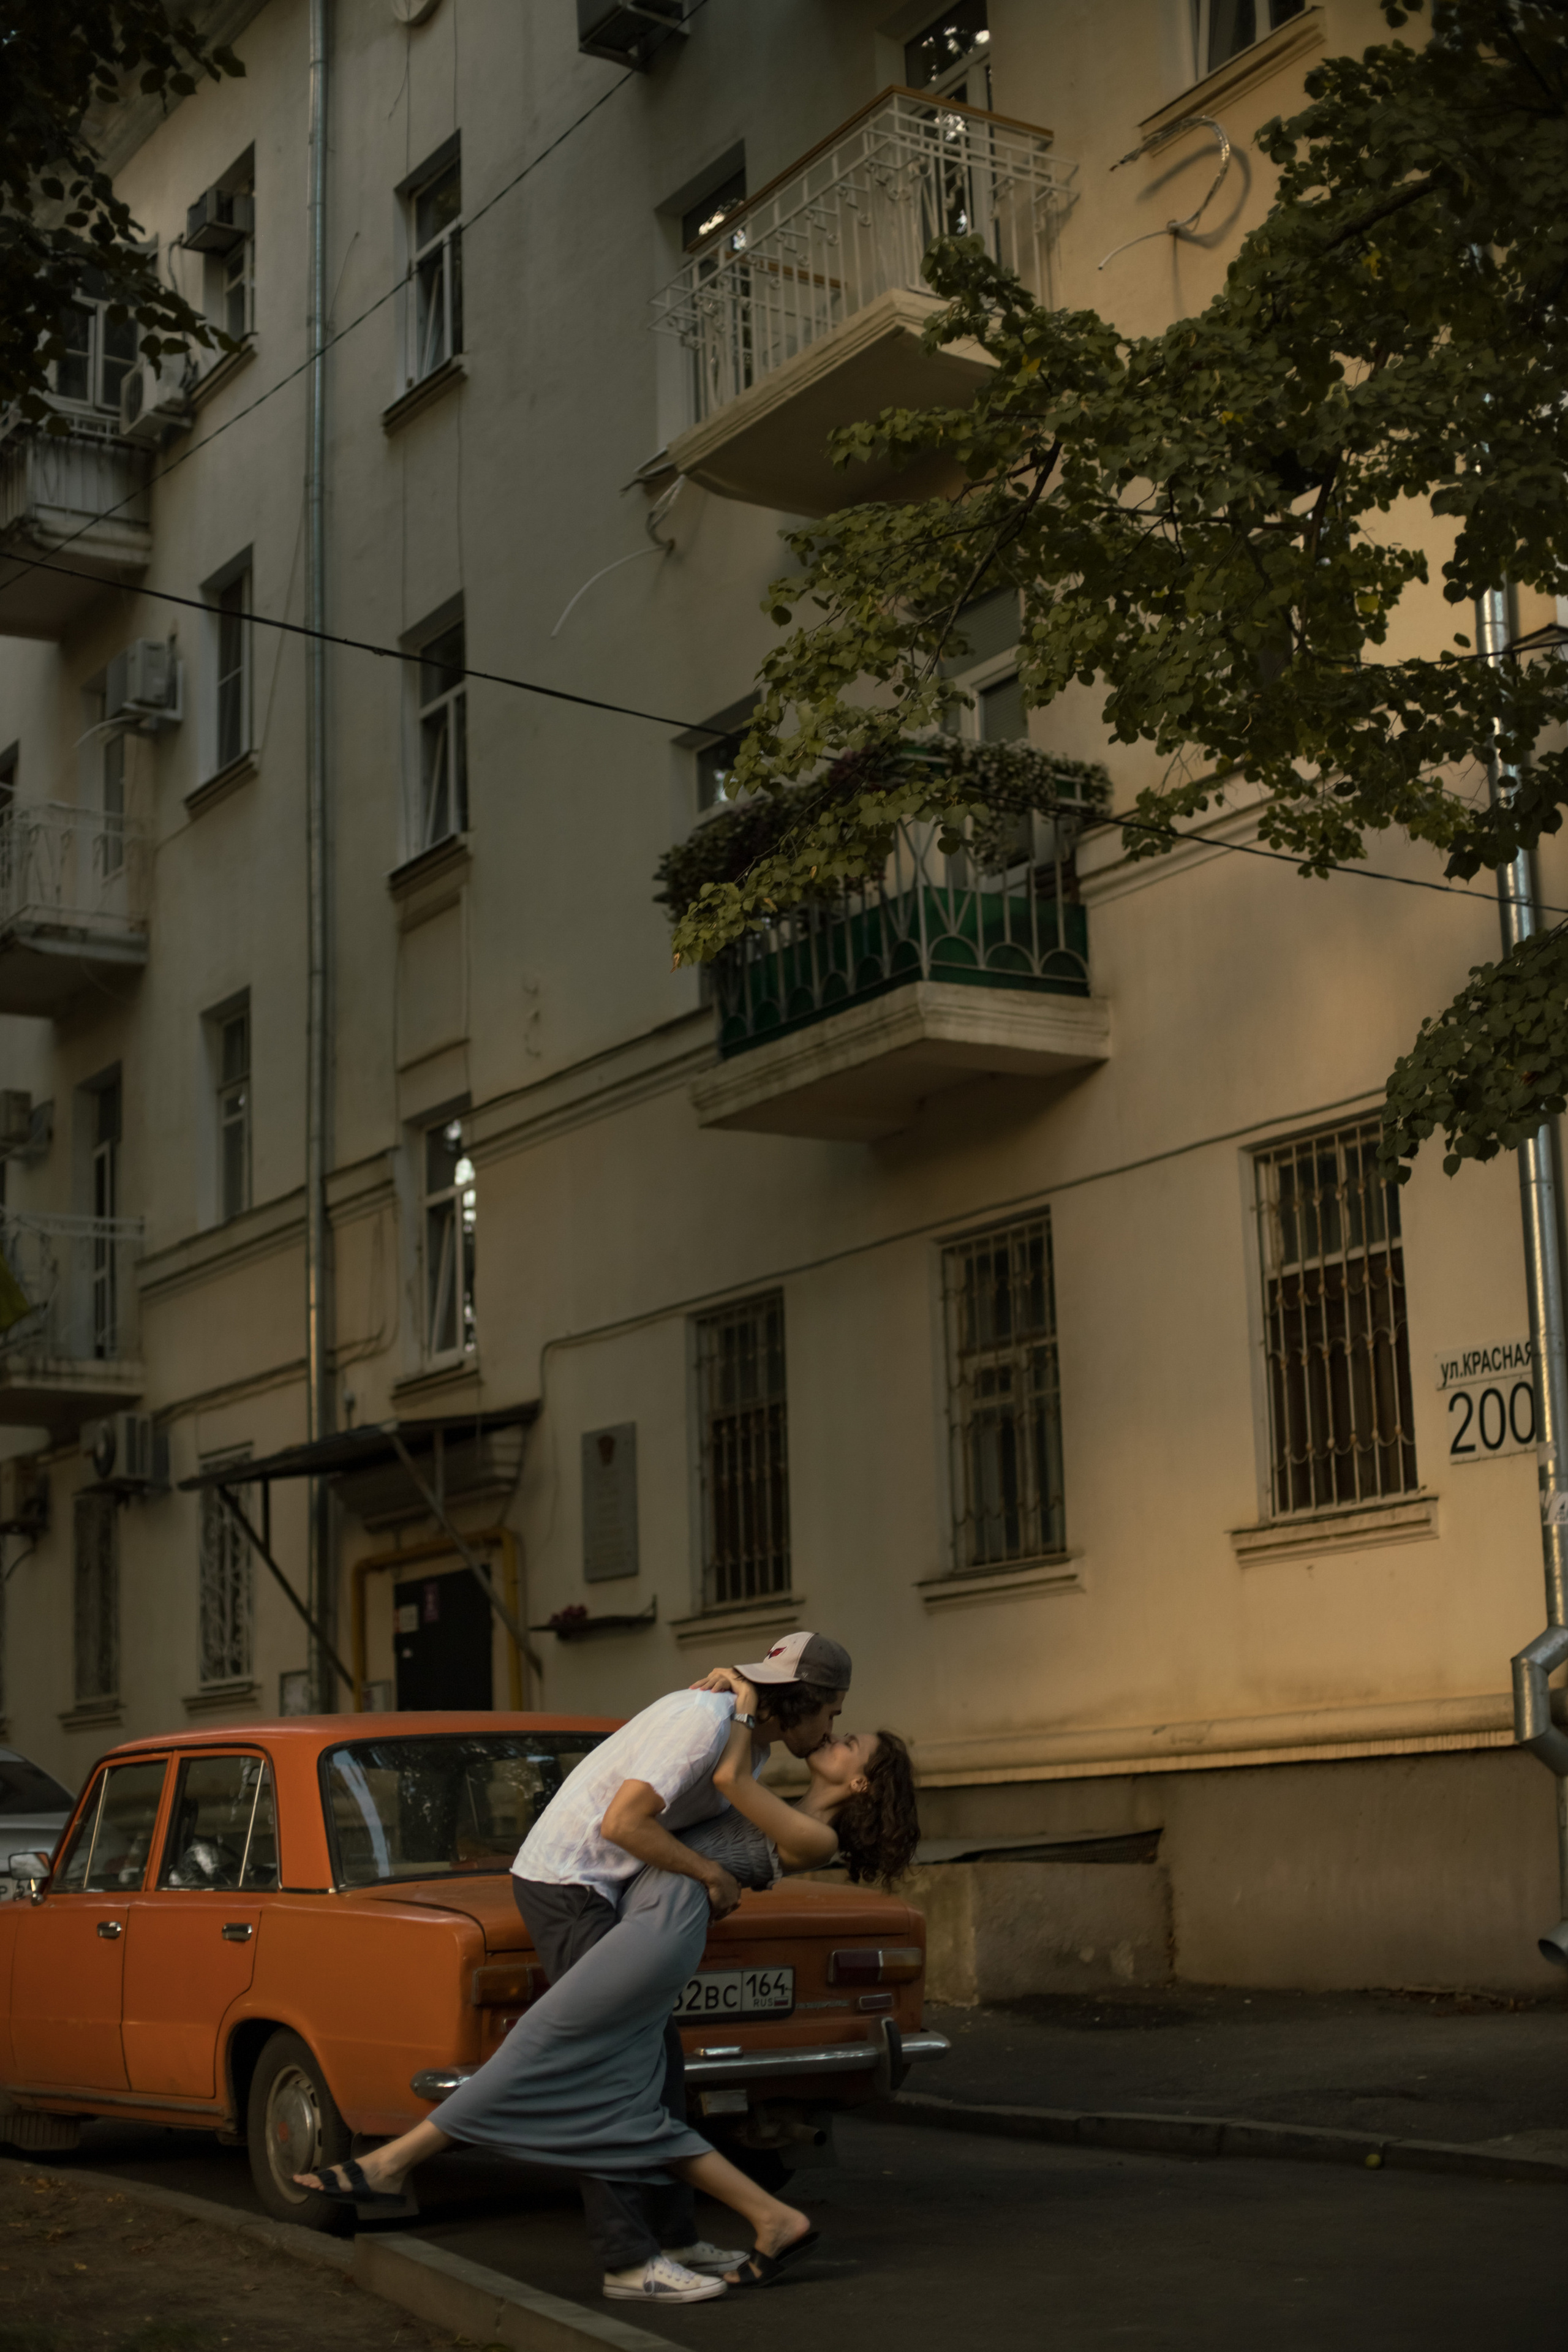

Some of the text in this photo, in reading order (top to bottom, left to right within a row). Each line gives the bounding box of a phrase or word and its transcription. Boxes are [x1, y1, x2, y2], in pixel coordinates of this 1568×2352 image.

[1449, 1382, 1536, 1455] 200
[746, 1972, 785, 1997] 164
[753, 1998, 773, 2007] RUS
